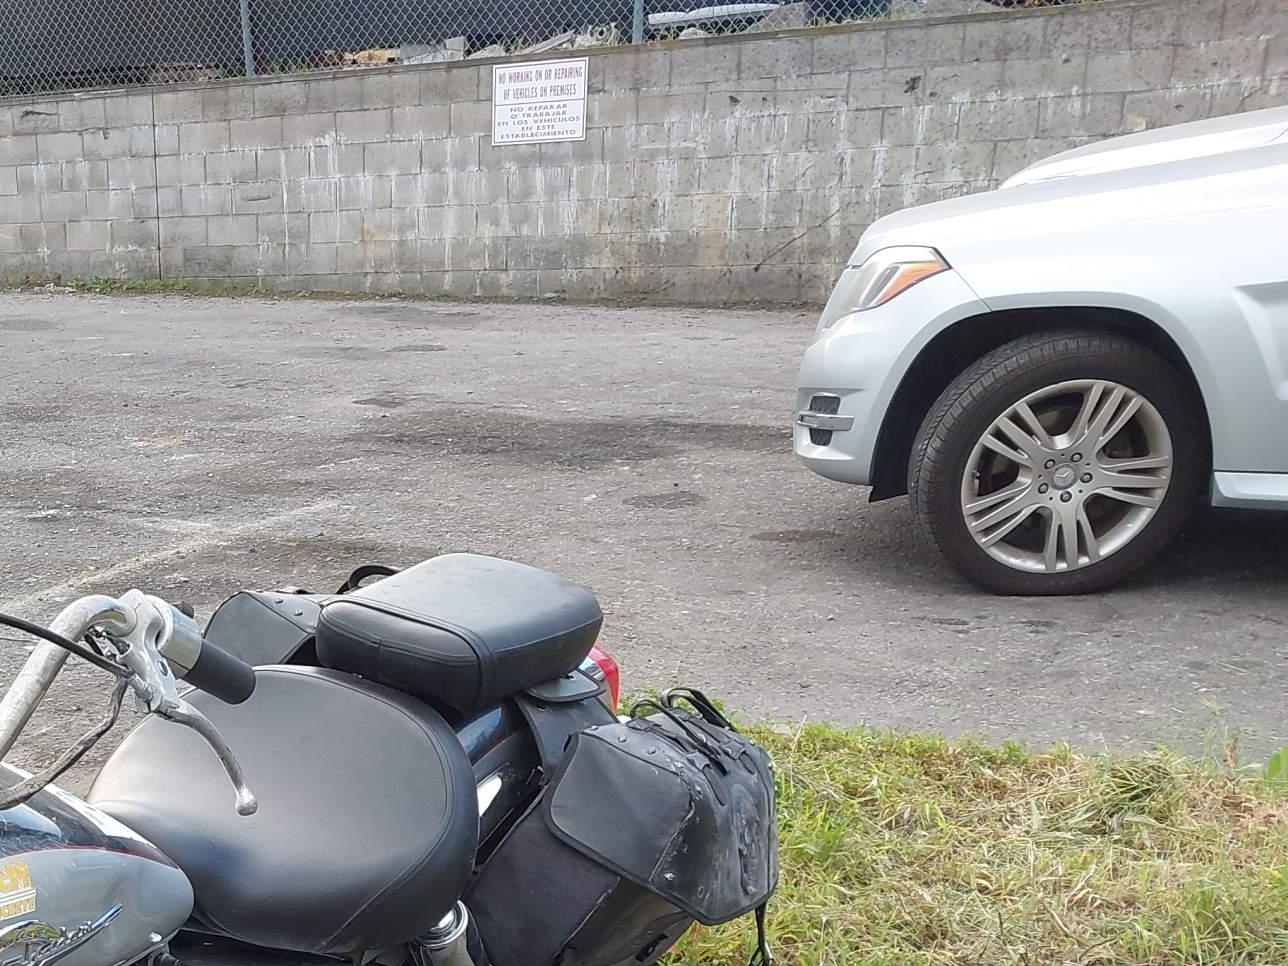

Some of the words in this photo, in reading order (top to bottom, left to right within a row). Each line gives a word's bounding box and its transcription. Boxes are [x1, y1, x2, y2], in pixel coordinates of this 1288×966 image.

[498, 72, 506, 84] NO
[509, 71, 533, 84] WORKING
[535, 70, 543, 82] ON
[545, 69, 553, 81] OR
[555, 66, 583, 80] REPAIRING
[503, 88, 511, 100] OF
[513, 86, 538, 100] VEHICLES
[540, 86, 548, 98] ON
[550, 84, 577, 97] PREMISES
[528, 103, 568, 112] REPARAR
[533, 116, 581, 124] VEHICULOS
[500, 129, 576, 140] ESTABLECIMIENTO
